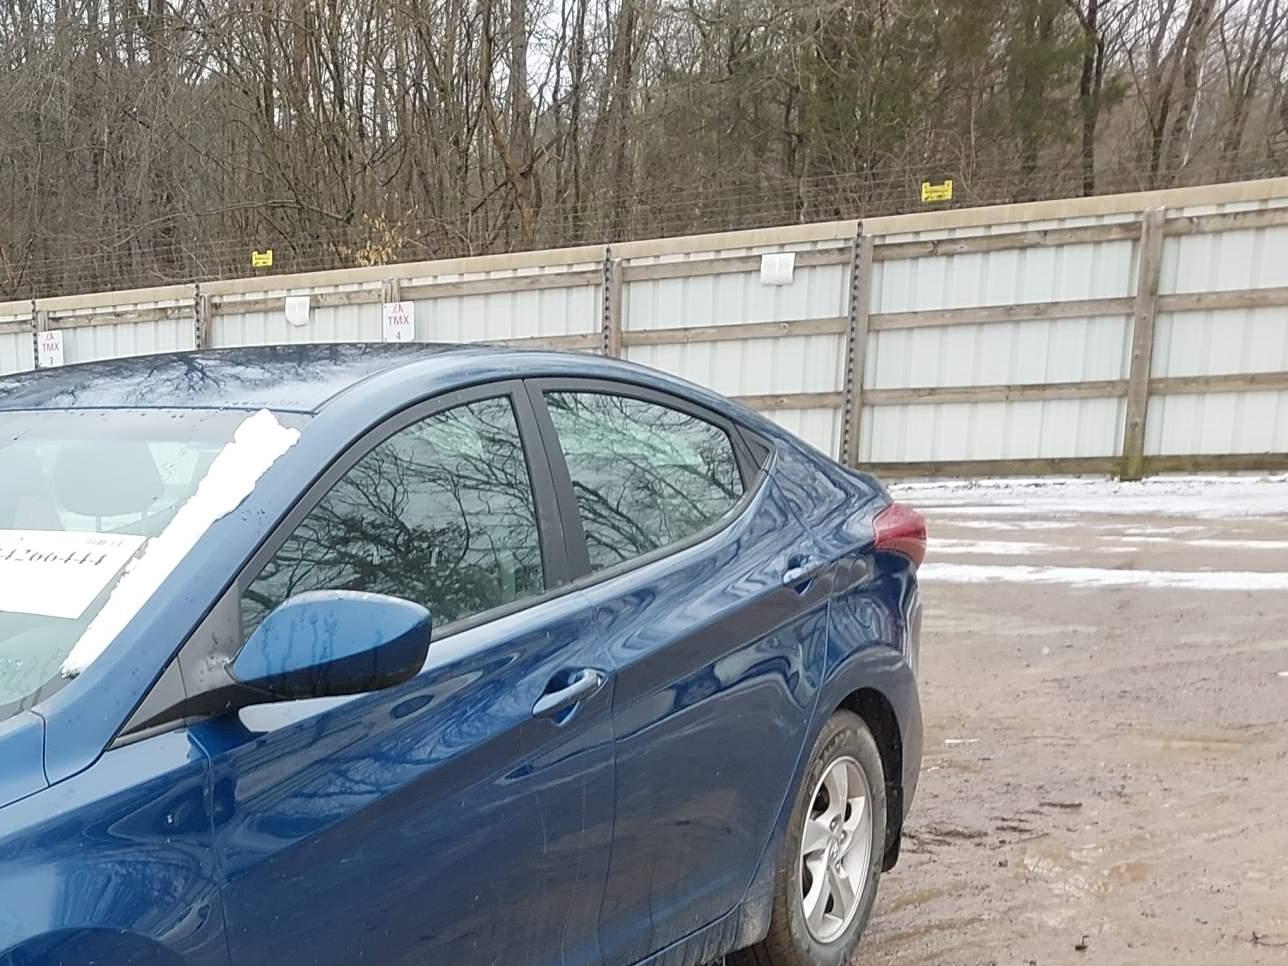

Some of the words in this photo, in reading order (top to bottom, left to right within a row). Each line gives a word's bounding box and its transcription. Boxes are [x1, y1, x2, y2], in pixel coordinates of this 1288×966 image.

[387, 315, 409, 326] TMX
[395, 331, 401, 340] 4
[42, 342, 60, 352] TMX
